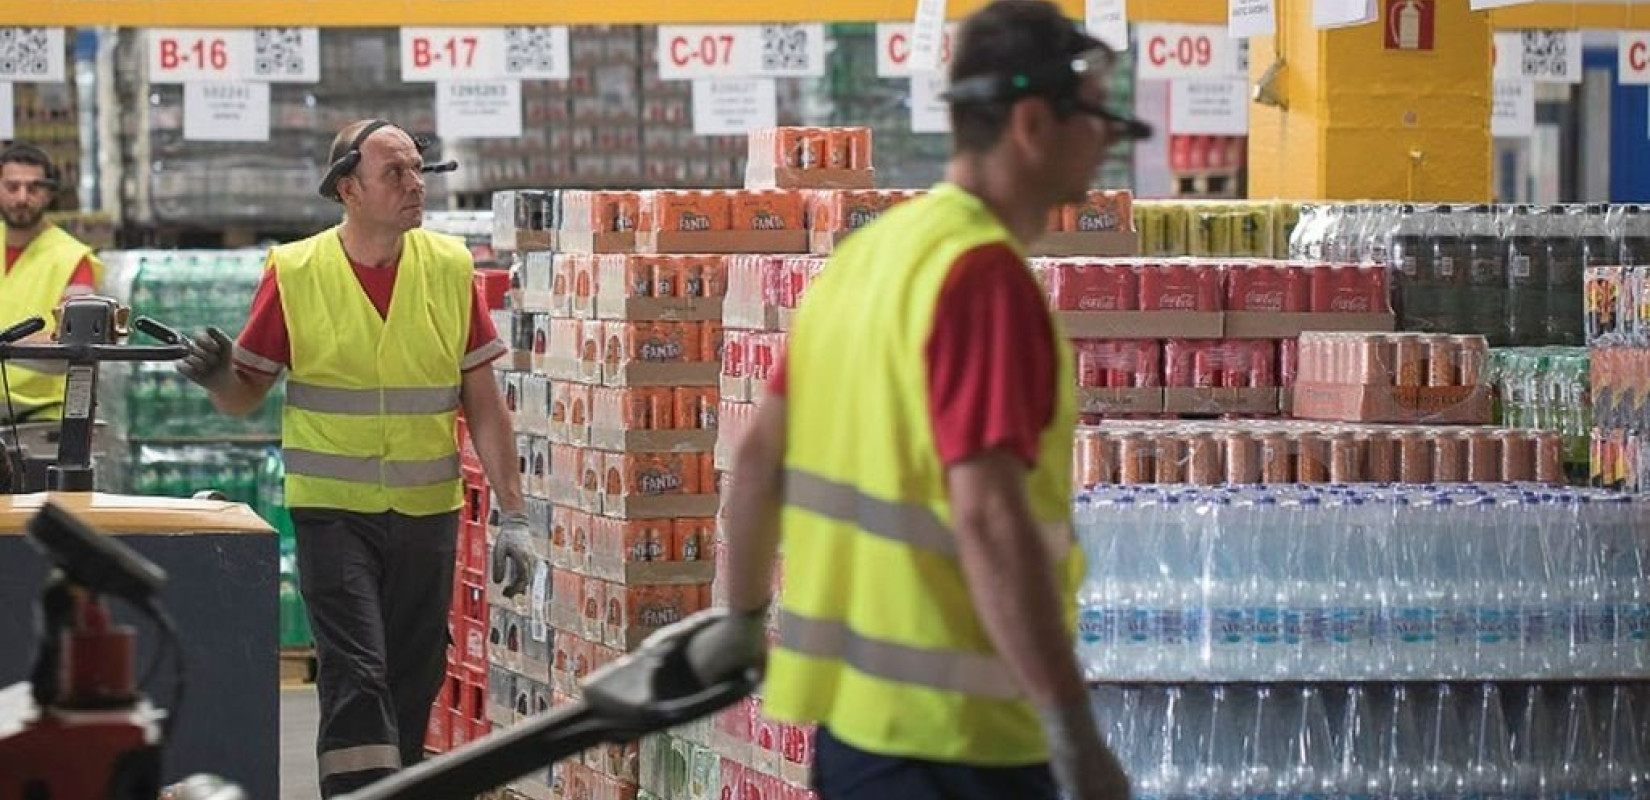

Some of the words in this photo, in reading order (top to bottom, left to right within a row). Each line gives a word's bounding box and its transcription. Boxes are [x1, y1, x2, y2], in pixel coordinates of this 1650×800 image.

[159, 38, 228, 71] B-16
[412, 36, 478, 69] B-17
[669, 35, 734, 67] C-07
[1147, 35, 1213, 67] C-09
